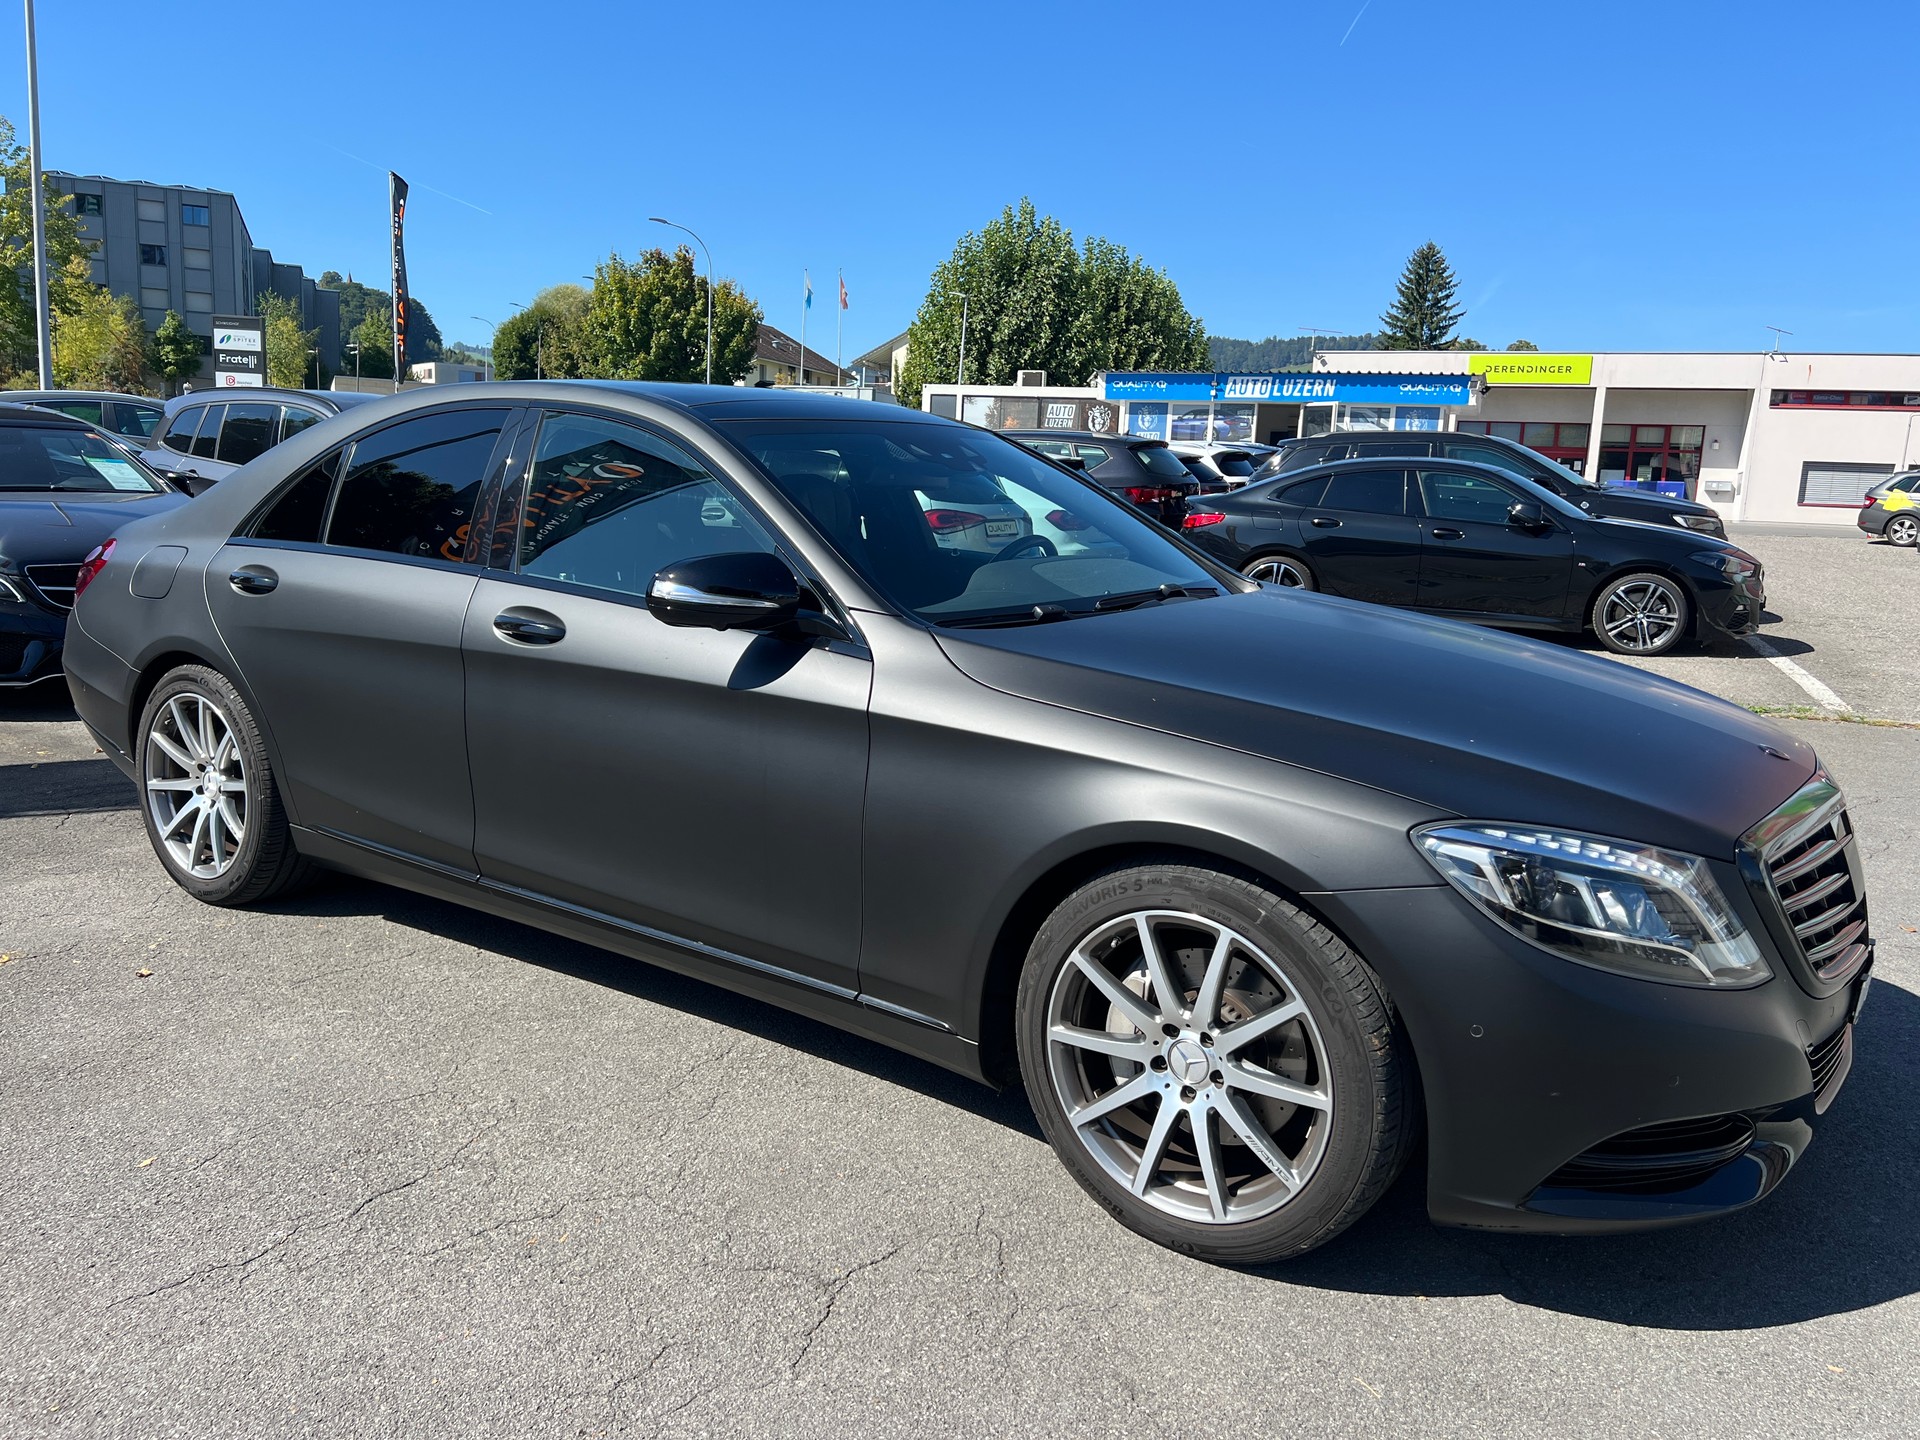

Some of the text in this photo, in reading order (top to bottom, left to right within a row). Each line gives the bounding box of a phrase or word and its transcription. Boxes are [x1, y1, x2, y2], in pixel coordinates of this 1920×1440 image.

[219, 354, 257, 368] Fratelli
[1485, 365, 1573, 374] DERENDINGER
[1227, 378, 1336, 397] AUTO LUZERN
[1048, 404, 1074, 417] AUTO
[1044, 418, 1074, 428] LUZERN
[1133, 879, 1144, 892] 5
